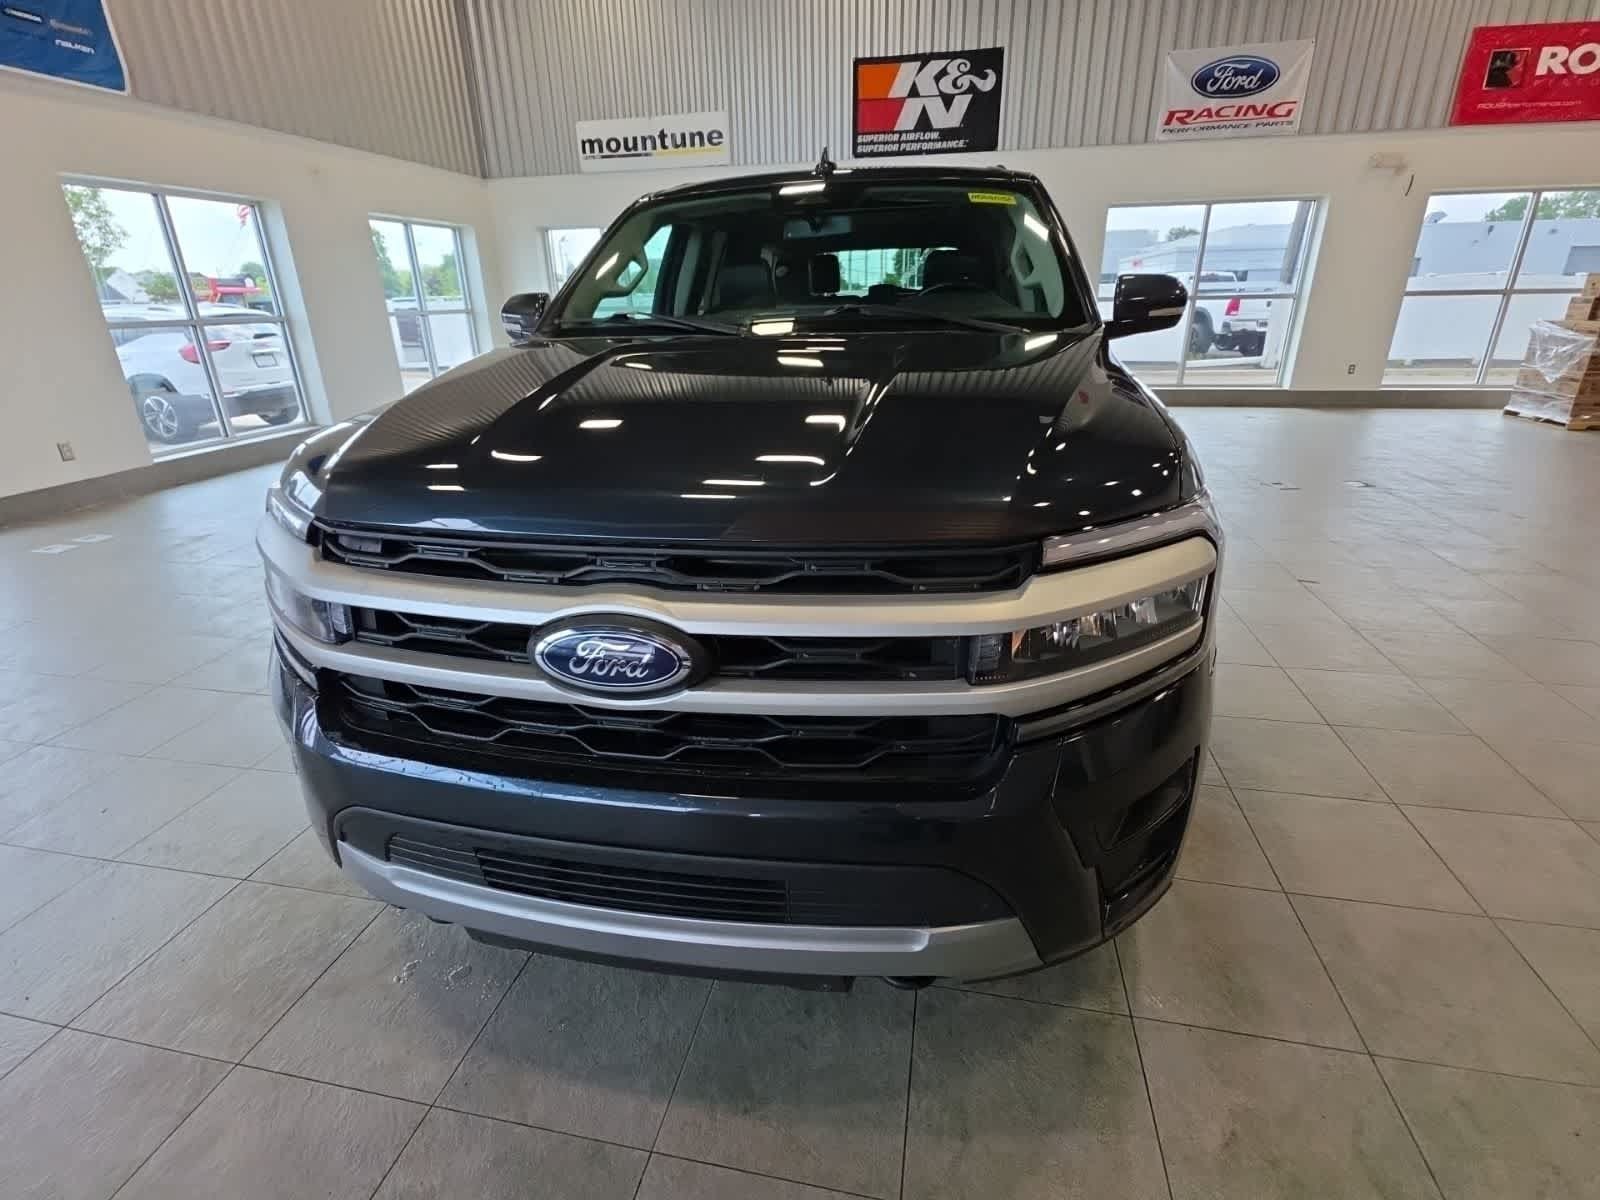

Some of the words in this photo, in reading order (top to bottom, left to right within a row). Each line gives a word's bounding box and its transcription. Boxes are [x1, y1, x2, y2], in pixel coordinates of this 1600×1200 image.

[1206, 63, 1265, 92] Ford
[1163, 101, 1297, 126] RACING
[857, 133, 900, 144] SUPERIOR
[900, 131, 941, 141] AIRFLOW.
[1161, 123, 1249, 134] PERFORMANCE
[1255, 119, 1294, 128] PARTS
[581, 128, 724, 154] mountune
[857, 143, 900, 153] SUPERIOR
[569, 639, 651, 678] Ford
